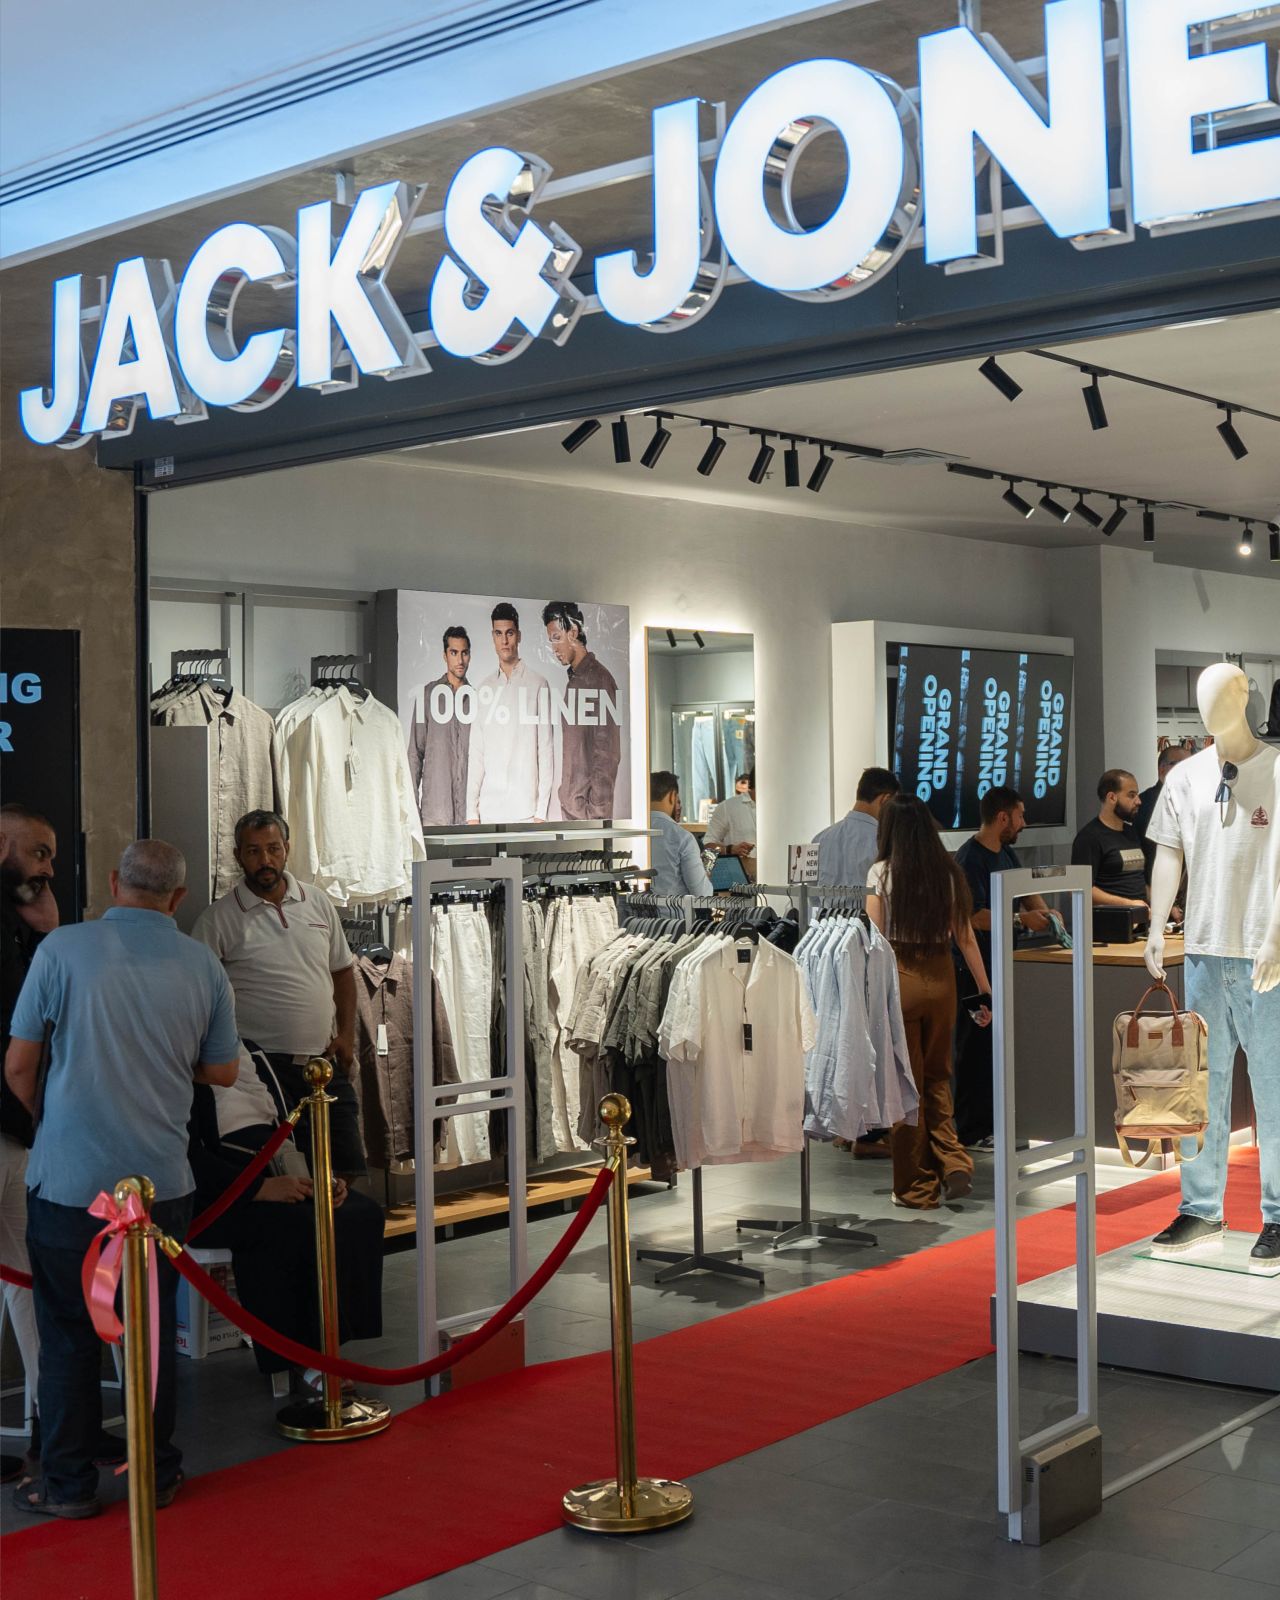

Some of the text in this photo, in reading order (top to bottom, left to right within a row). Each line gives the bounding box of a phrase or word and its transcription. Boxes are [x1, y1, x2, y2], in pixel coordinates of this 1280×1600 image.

[20, 182, 402, 445] JACK
[430, 146, 560, 358] &
[408, 683, 624, 727] 100% LINEN
[916, 674, 938, 803] OPENING
[933, 688, 952, 790] GRAND
[992, 690, 1011, 788] GRAND
[1033, 679, 1053, 799] OPENING
[1047, 692, 1065, 787] GRAND
